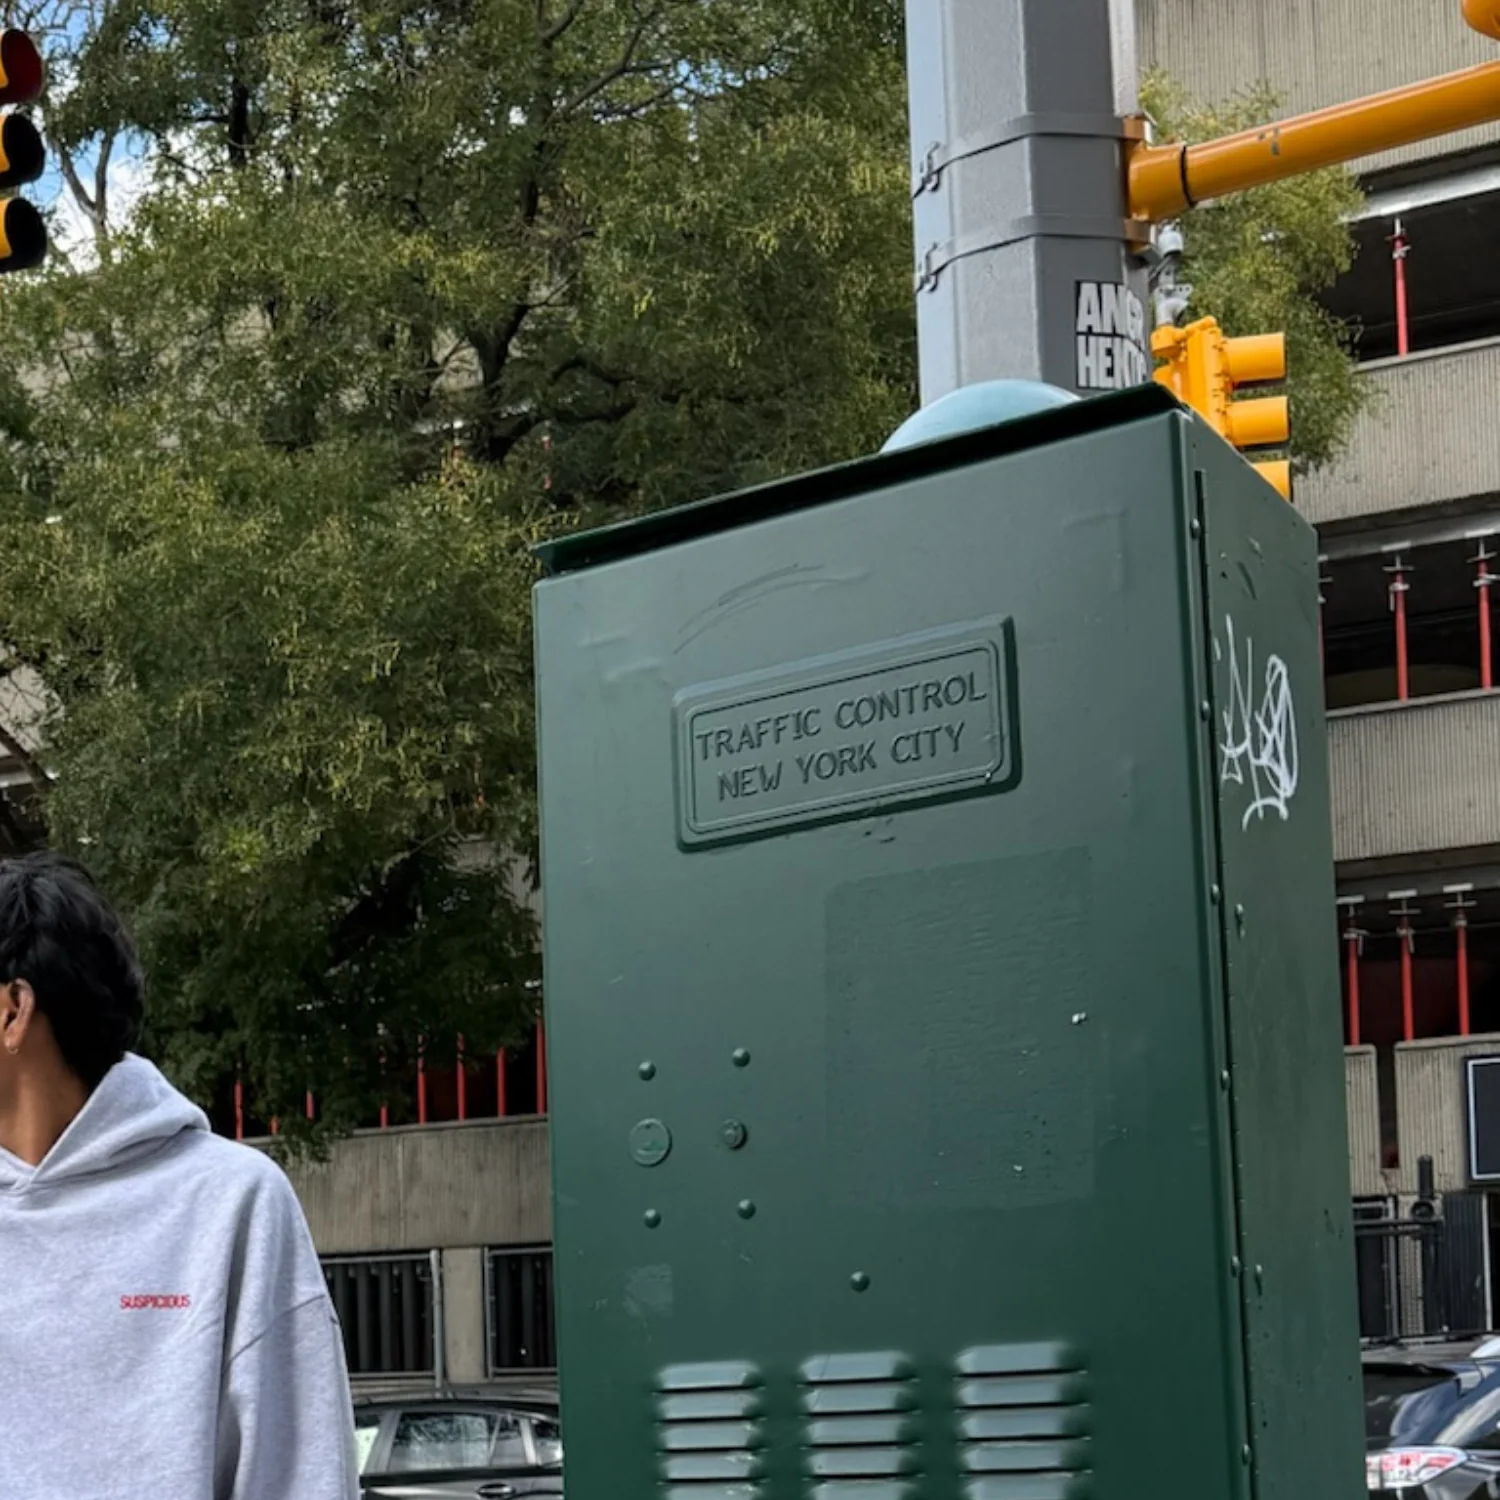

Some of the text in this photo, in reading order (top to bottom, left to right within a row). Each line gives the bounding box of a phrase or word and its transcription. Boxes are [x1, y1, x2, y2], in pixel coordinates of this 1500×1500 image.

[696, 672, 987, 761] TRAFFIC CONTROL
[717, 721, 967, 801] NEW YORK CITY
[119, 1294, 191, 1310] SUSPICIOUS
